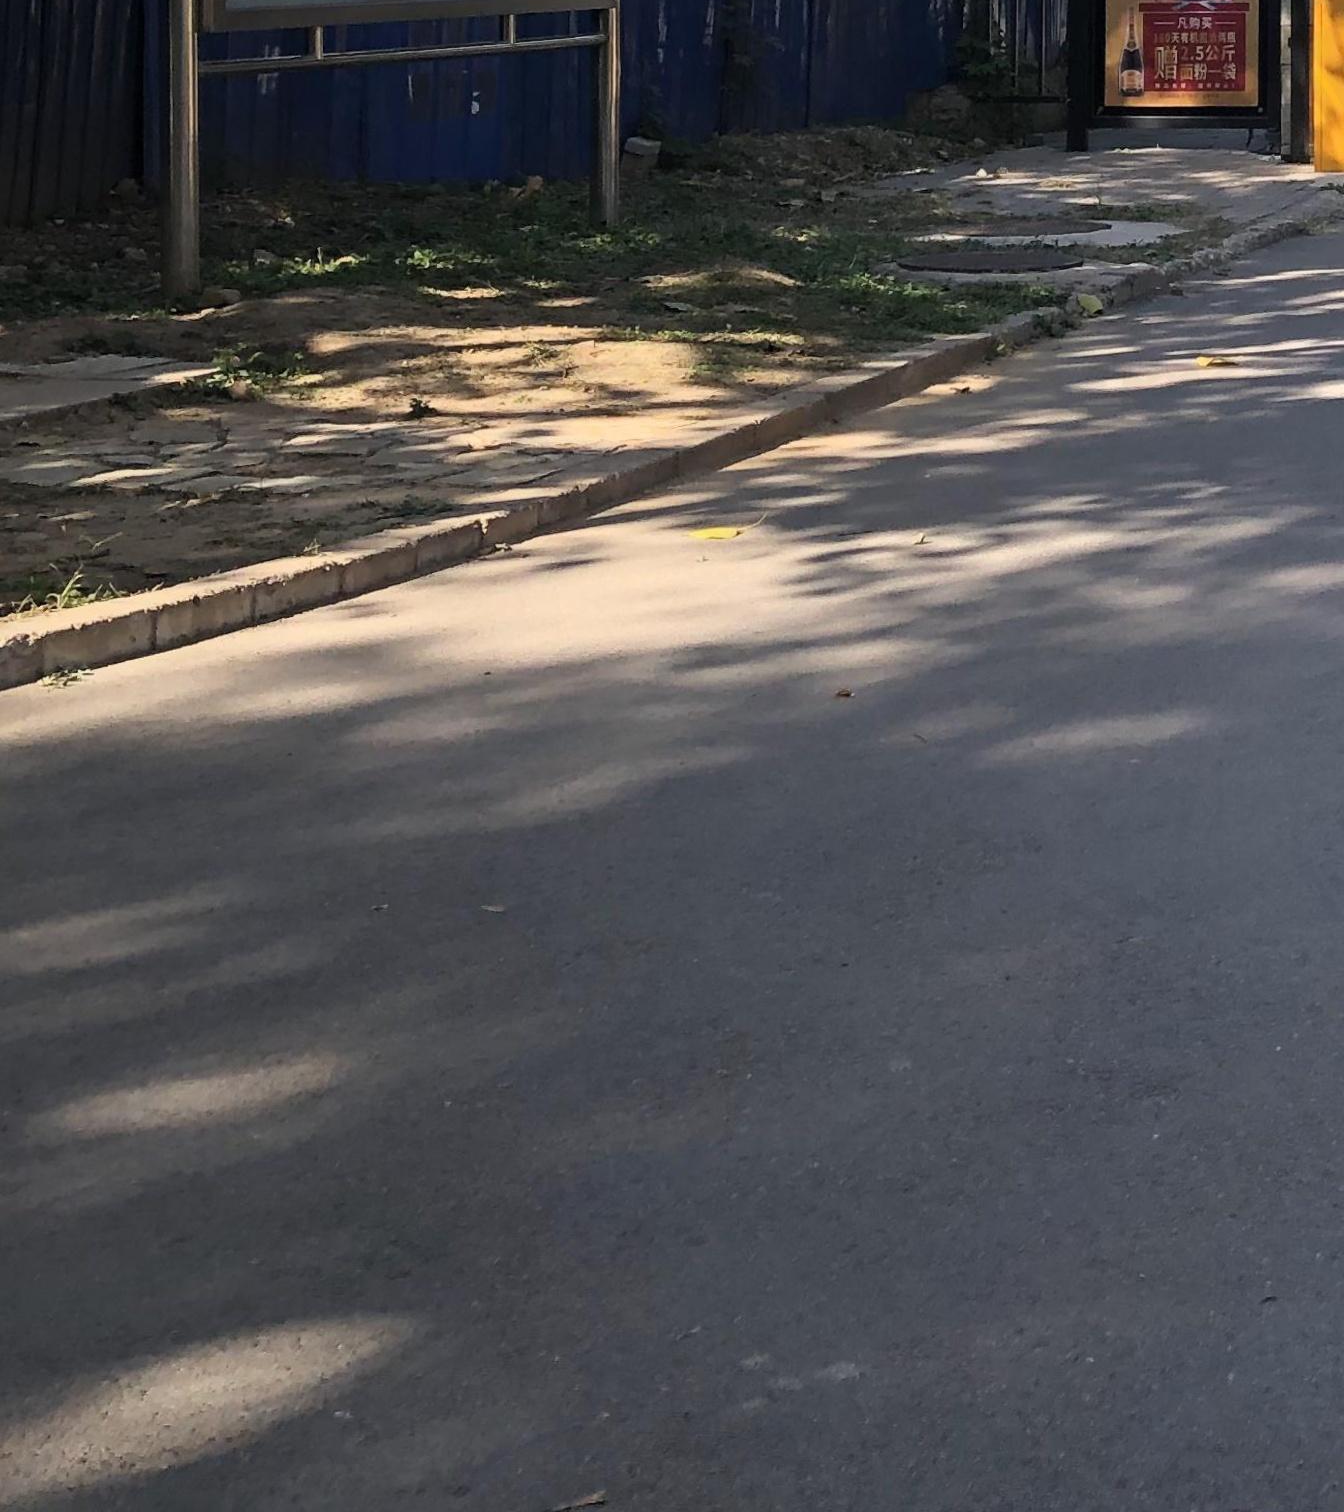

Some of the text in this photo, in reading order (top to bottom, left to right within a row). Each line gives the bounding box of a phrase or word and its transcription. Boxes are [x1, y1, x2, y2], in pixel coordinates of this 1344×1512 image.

[1177, 16, 1213, 30] 凡购买
[1181, 45, 1236, 62] 2.5公斤
[1154, 45, 1178, 80] 赠
[1180, 63, 1237, 80] 面粉一袋
